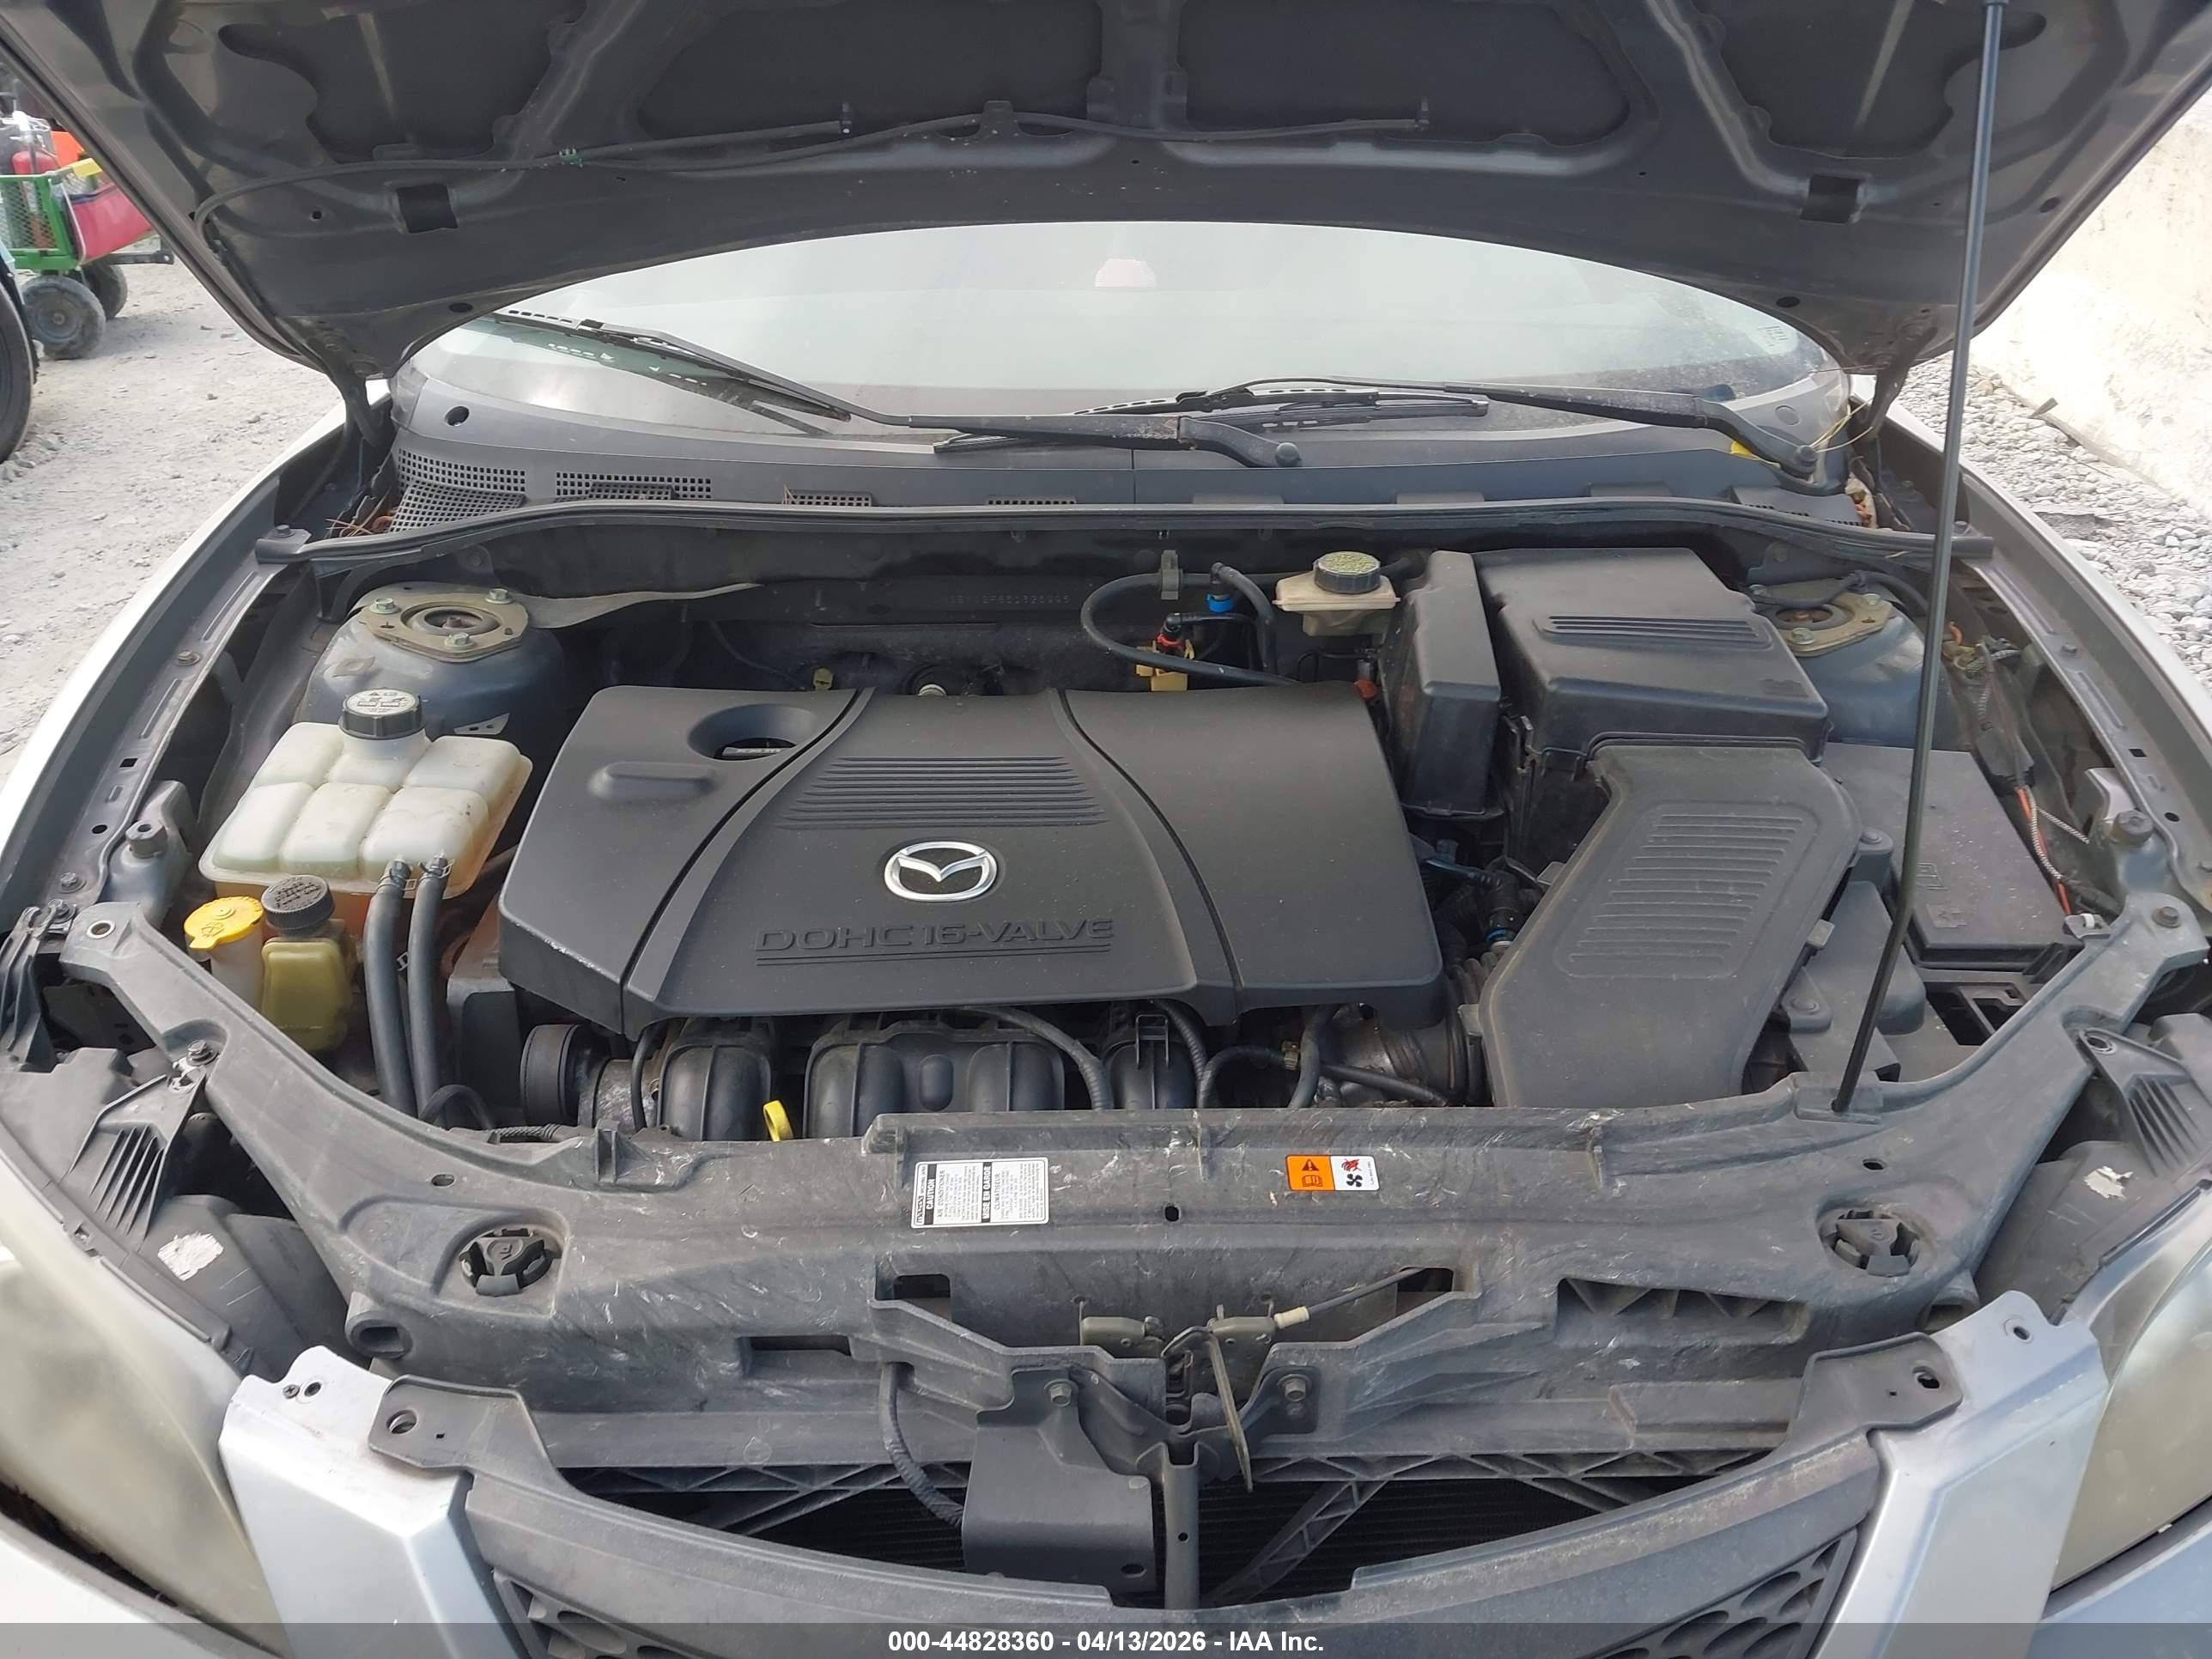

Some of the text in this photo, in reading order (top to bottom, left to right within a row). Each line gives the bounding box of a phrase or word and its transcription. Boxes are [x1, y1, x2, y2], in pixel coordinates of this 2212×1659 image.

[755, 919, 1115, 951] DOHC 16-VALVE
[926, 1178, 935, 1210] CAUTION
[982, 1190, 990, 1201] EN
